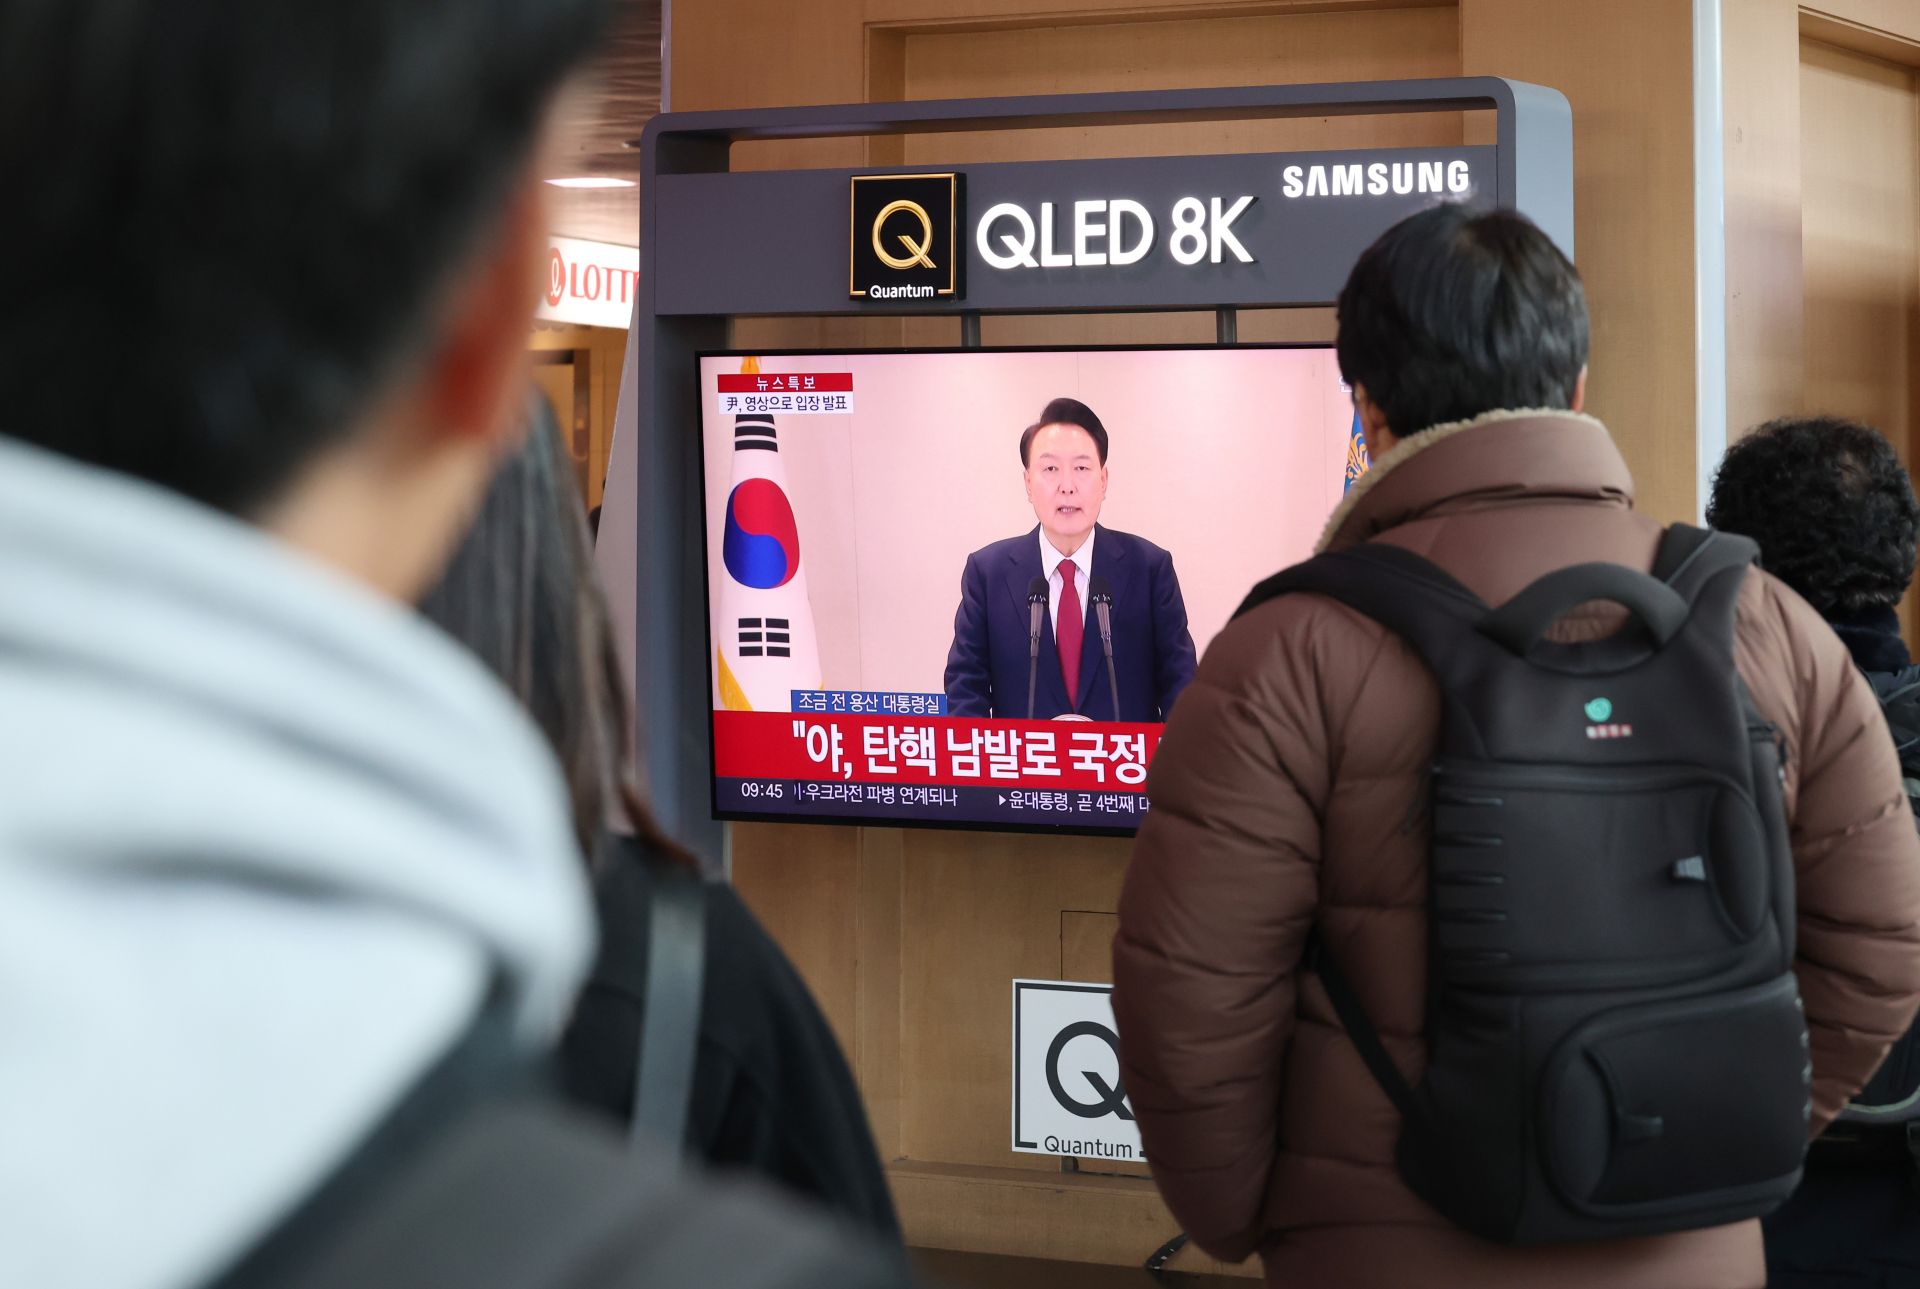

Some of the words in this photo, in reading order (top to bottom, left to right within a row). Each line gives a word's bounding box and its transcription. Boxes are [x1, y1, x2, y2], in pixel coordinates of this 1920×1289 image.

[1283, 160, 1469, 198] SAMSUNG
[976, 199, 1156, 270] QLED
[1169, 196, 1255, 266] 8K
[870, 284, 934, 300] Quantum
[726, 396, 742, 413] 尹,
[745, 396, 793, 412] 영상으로
[796, 395, 820, 411] 입장
[822, 395, 848, 411] 발표
[799, 692, 828, 711] 조금
[831, 692, 846, 712] 전
[849, 693, 879, 713] 용산
[883, 694, 940, 715] 대통령실
[792, 720, 853, 780] "야,
[863, 725, 937, 777] 탄핵
[946, 728, 1062, 779] 남발로
[1068, 733, 1148, 785] 국정
[741, 782, 783, 798] 09:45
[866, 785, 896, 804] 파병
[900, 786, 957, 807] 연계되나
[1009, 790, 1073, 813] 윤대통령,
[1077, 793, 1093, 812] 곧
[1096, 794, 1135, 814] 4번째
[1044, 1135, 1133, 1158] Quantum
